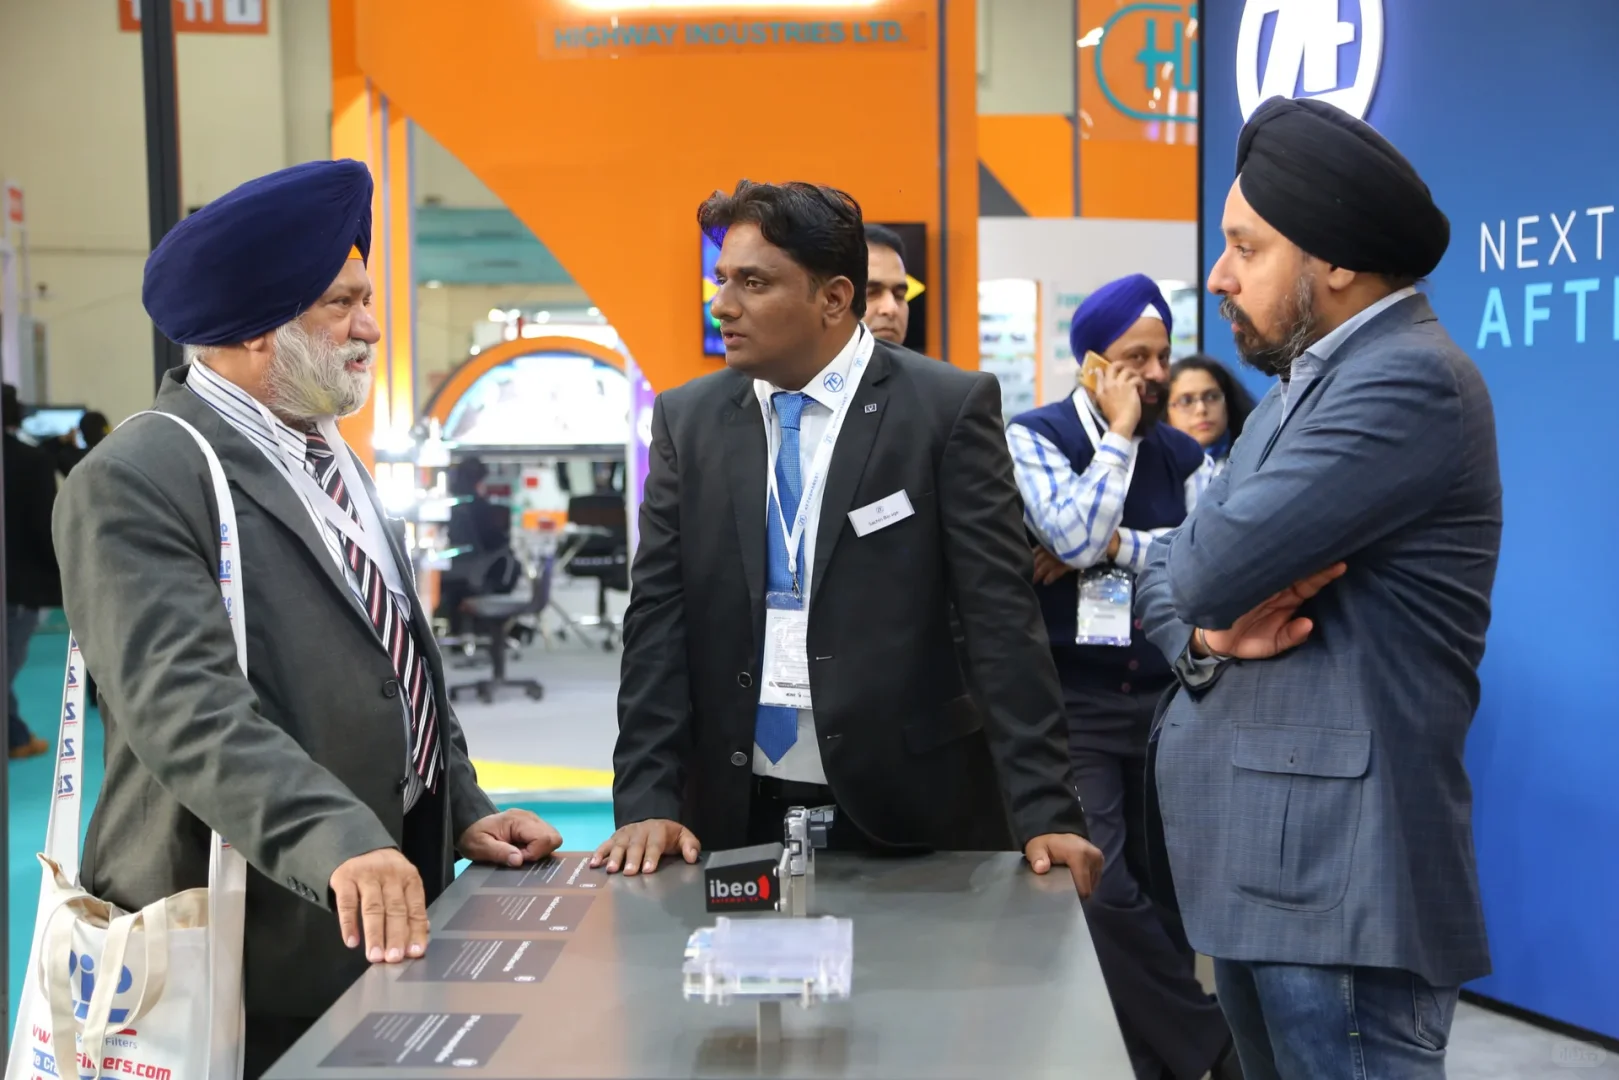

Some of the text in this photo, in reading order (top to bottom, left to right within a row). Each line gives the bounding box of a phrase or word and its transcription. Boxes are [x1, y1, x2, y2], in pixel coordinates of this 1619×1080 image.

[554, 20, 908, 48] HIGHWAY INDUSTRIES LTD.
[1480, 205, 1614, 273] NEXT
[709, 879, 757, 897] ibeo
[105, 1037, 137, 1049] Filters
